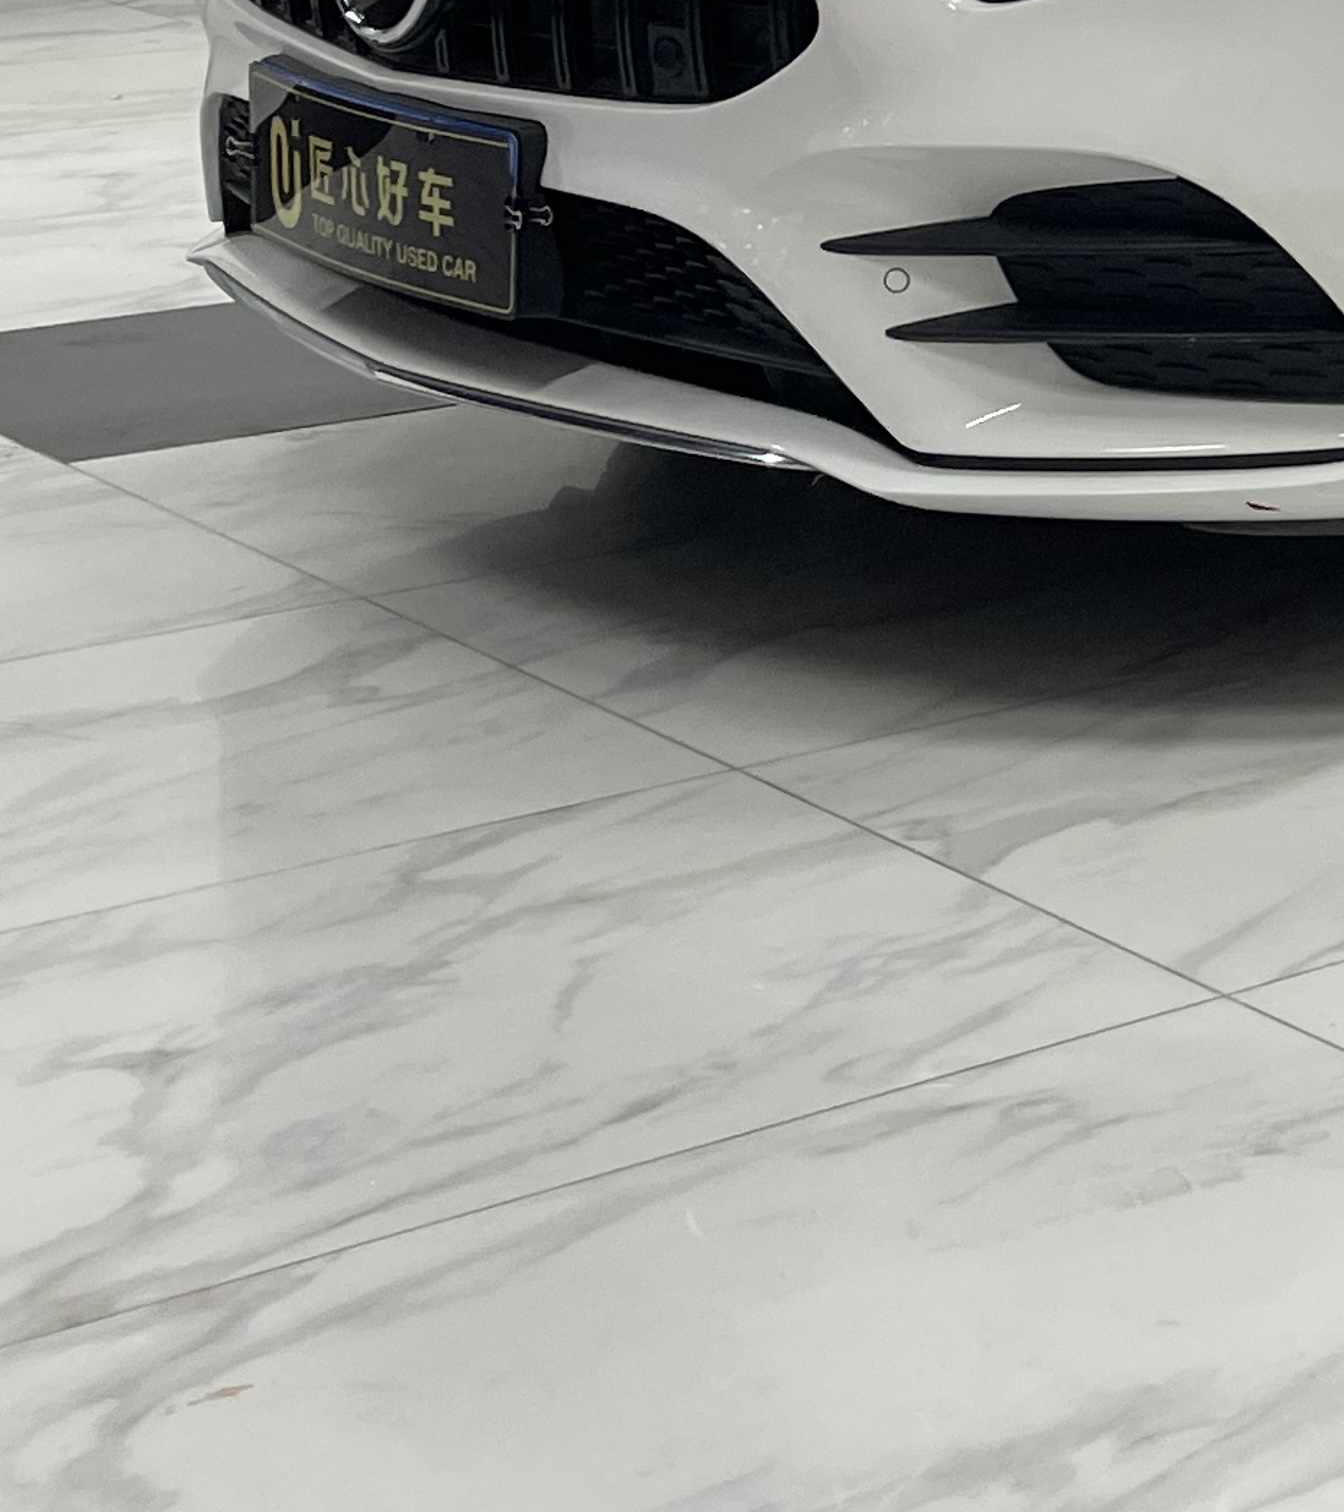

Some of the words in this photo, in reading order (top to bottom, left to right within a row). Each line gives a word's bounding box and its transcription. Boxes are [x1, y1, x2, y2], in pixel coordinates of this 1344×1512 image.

[308, 136, 454, 237] 匠心好车
[312, 213, 334, 238] TOP
[337, 224, 393, 259] QUALITY
[396, 244, 438, 272] USED
[442, 256, 477, 283] CAR
